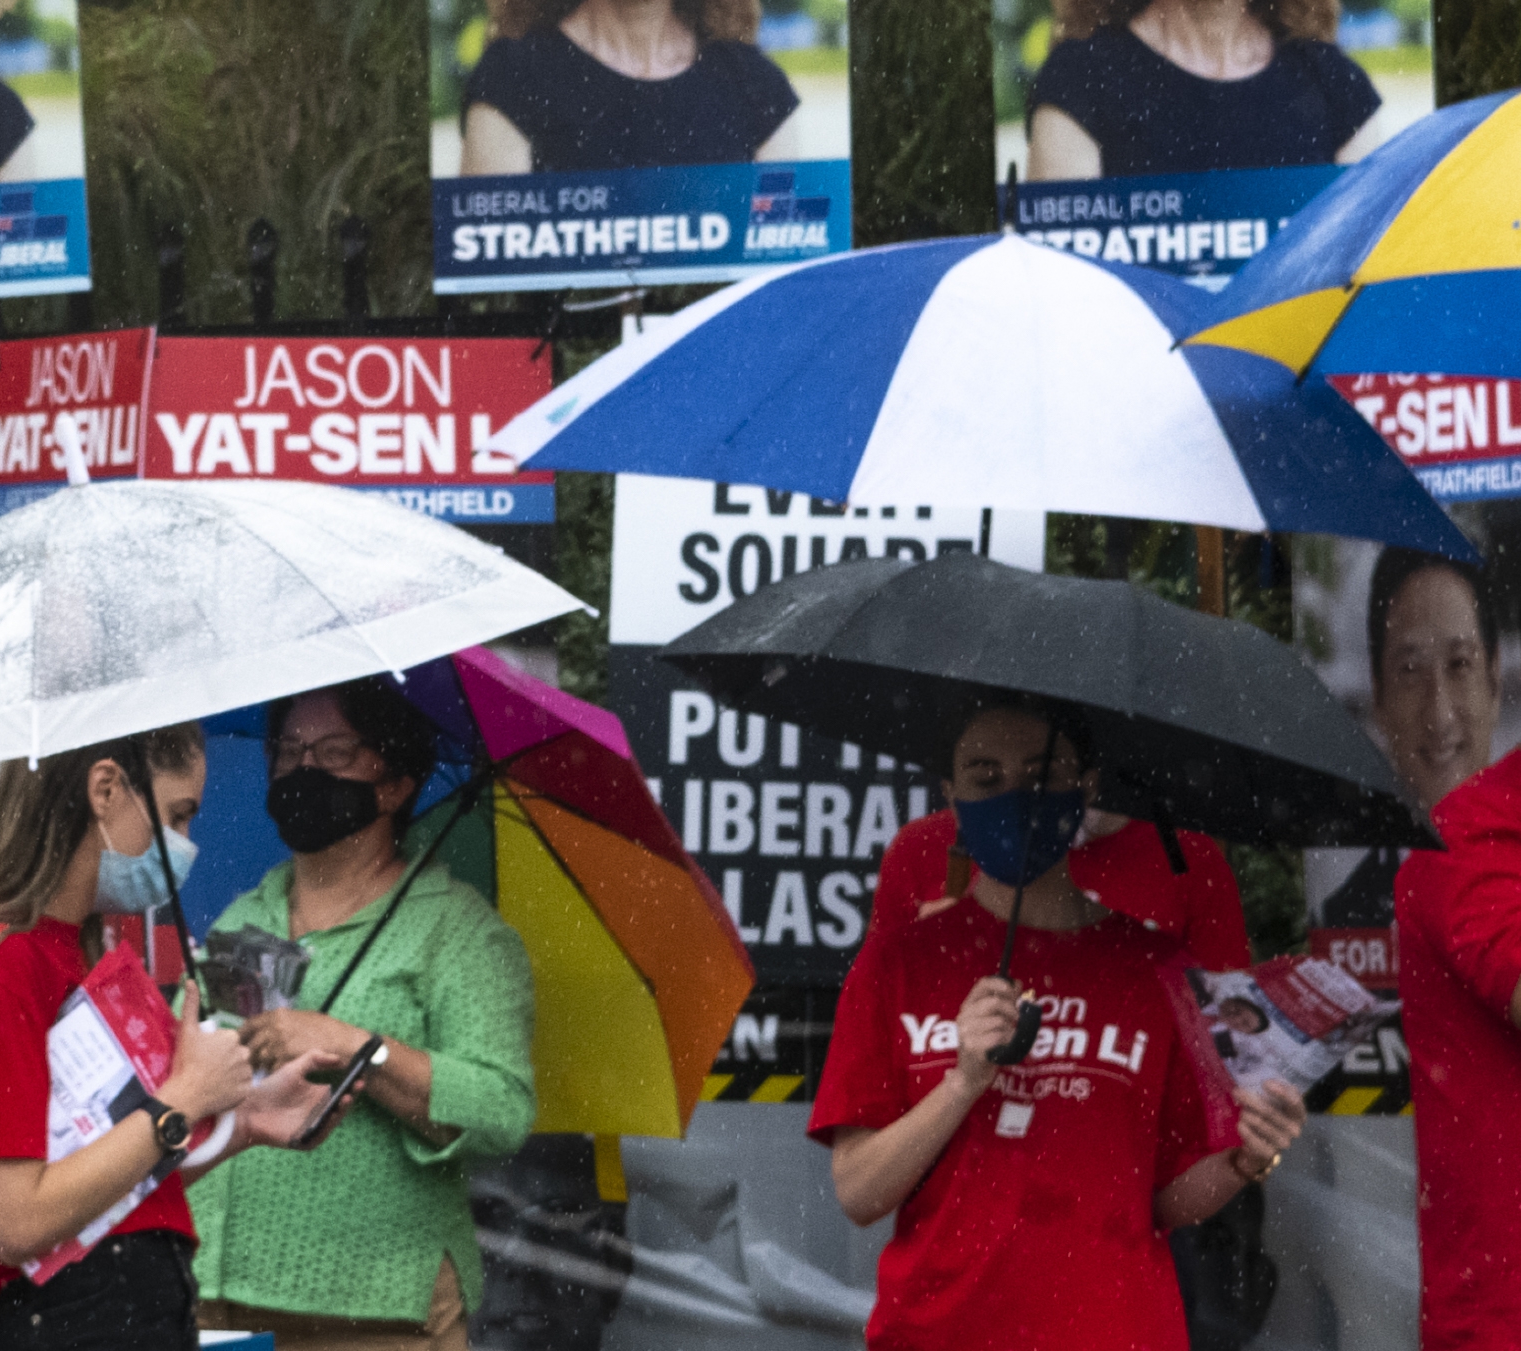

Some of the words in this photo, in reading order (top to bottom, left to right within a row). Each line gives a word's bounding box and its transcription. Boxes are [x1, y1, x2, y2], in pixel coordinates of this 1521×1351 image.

[453, 189, 554, 218] LIBERAL
[559, 185, 608, 211] FOR
[1019, 194, 1122, 224] LIBERAL
[1130, 190, 1182, 217] FOR
[454, 213, 731, 261] STRATHFIELD
[745, 222, 829, 249] LIBERAL
[26, 340, 117, 407] JASON
[234, 345, 451, 408] JASON
[155, 412, 440, 474] YAT-SEN
[723, 868, 878, 946] LAS
[1328, 938, 1387, 977] FOR
[1096, 1023, 1149, 1075] Li
